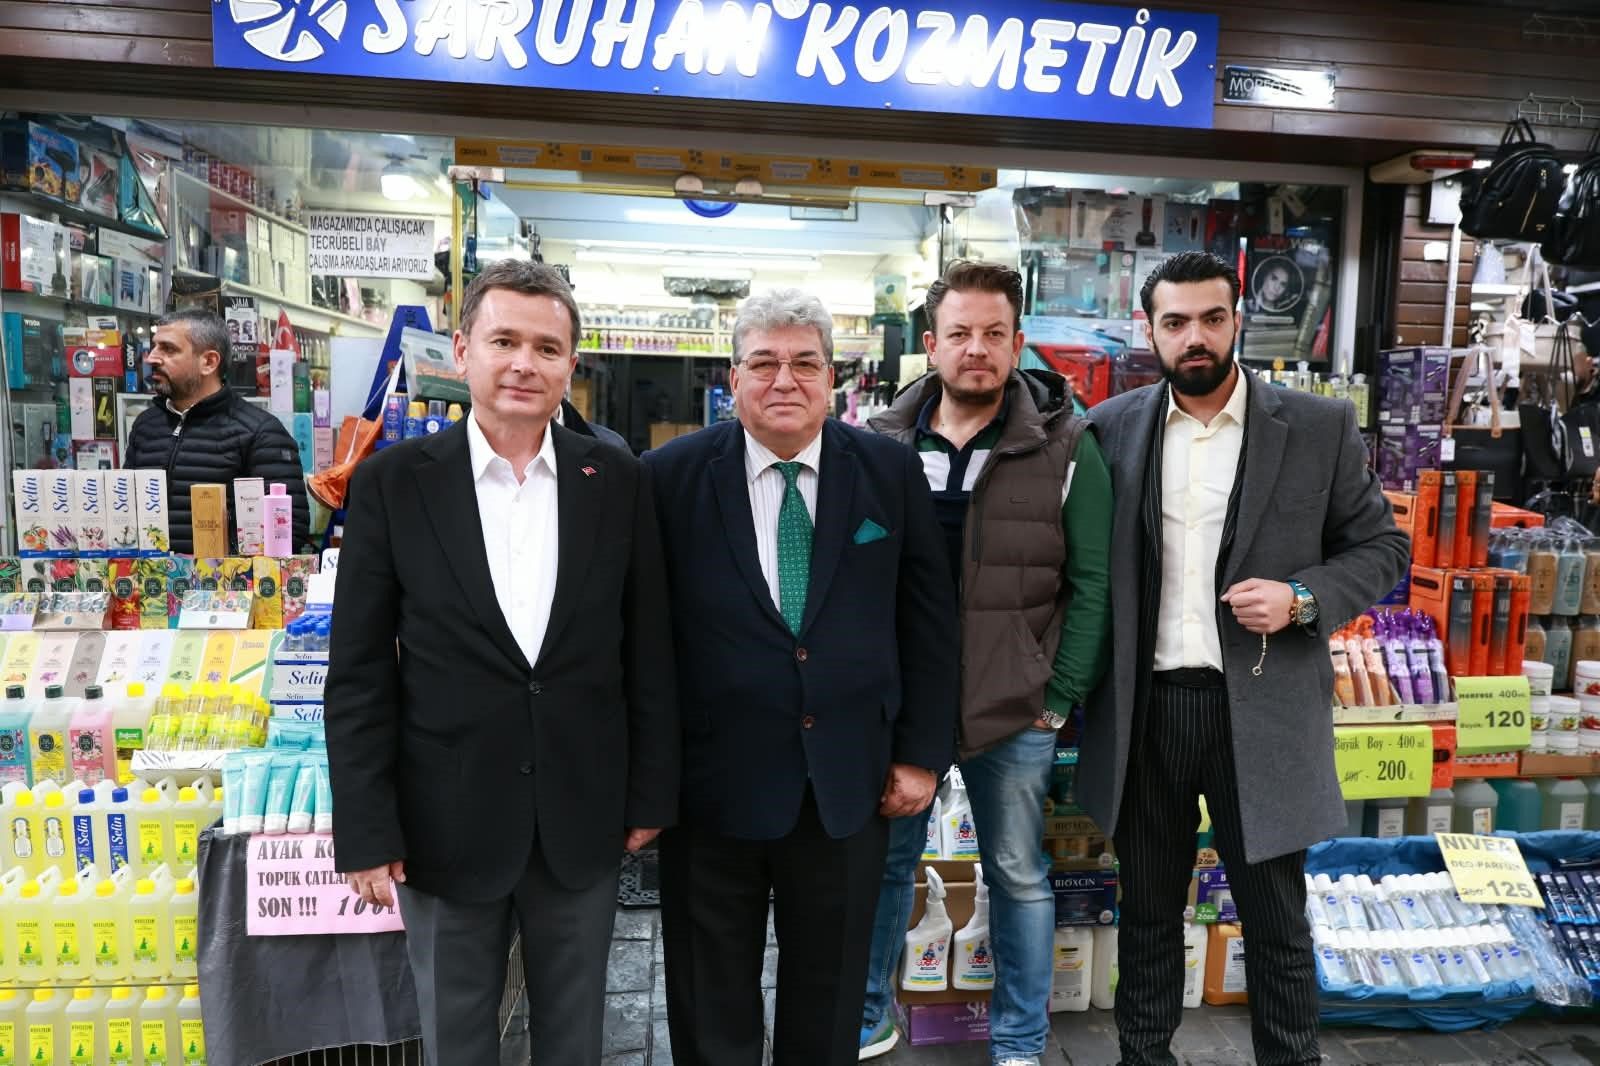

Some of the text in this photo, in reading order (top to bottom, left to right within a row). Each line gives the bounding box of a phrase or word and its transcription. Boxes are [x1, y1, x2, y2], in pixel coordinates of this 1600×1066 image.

[362, 0, 1198, 107] SARUHAN KOZMETİK
[374, 218, 425, 237] ÇALIŞACAK
[366, 239, 387, 251] BAY
[22, 477, 39, 513] Selin
[51, 477, 70, 513] Selin
[82, 478, 99, 514] Selin
[112, 477, 129, 513] Selin
[145, 478, 161, 513] Selin
[291, 708, 323, 721] Seli
[1485, 710, 1525, 727] 120
[1367, 735, 1384, 751] Boy
[1377, 759, 1406, 781] 200
[77, 818, 90, 846] Selin
[111, 816, 124, 845] Selin
[257, 840, 303, 859] AYAK
[1441, 835, 1514, 853] NIVEA
[257, 871, 301, 886] TOPUK
[1055, 878, 1096, 888] BIOXCIN
[1487, 880, 1533, 898] 125
[258, 897, 292, 918] SON
